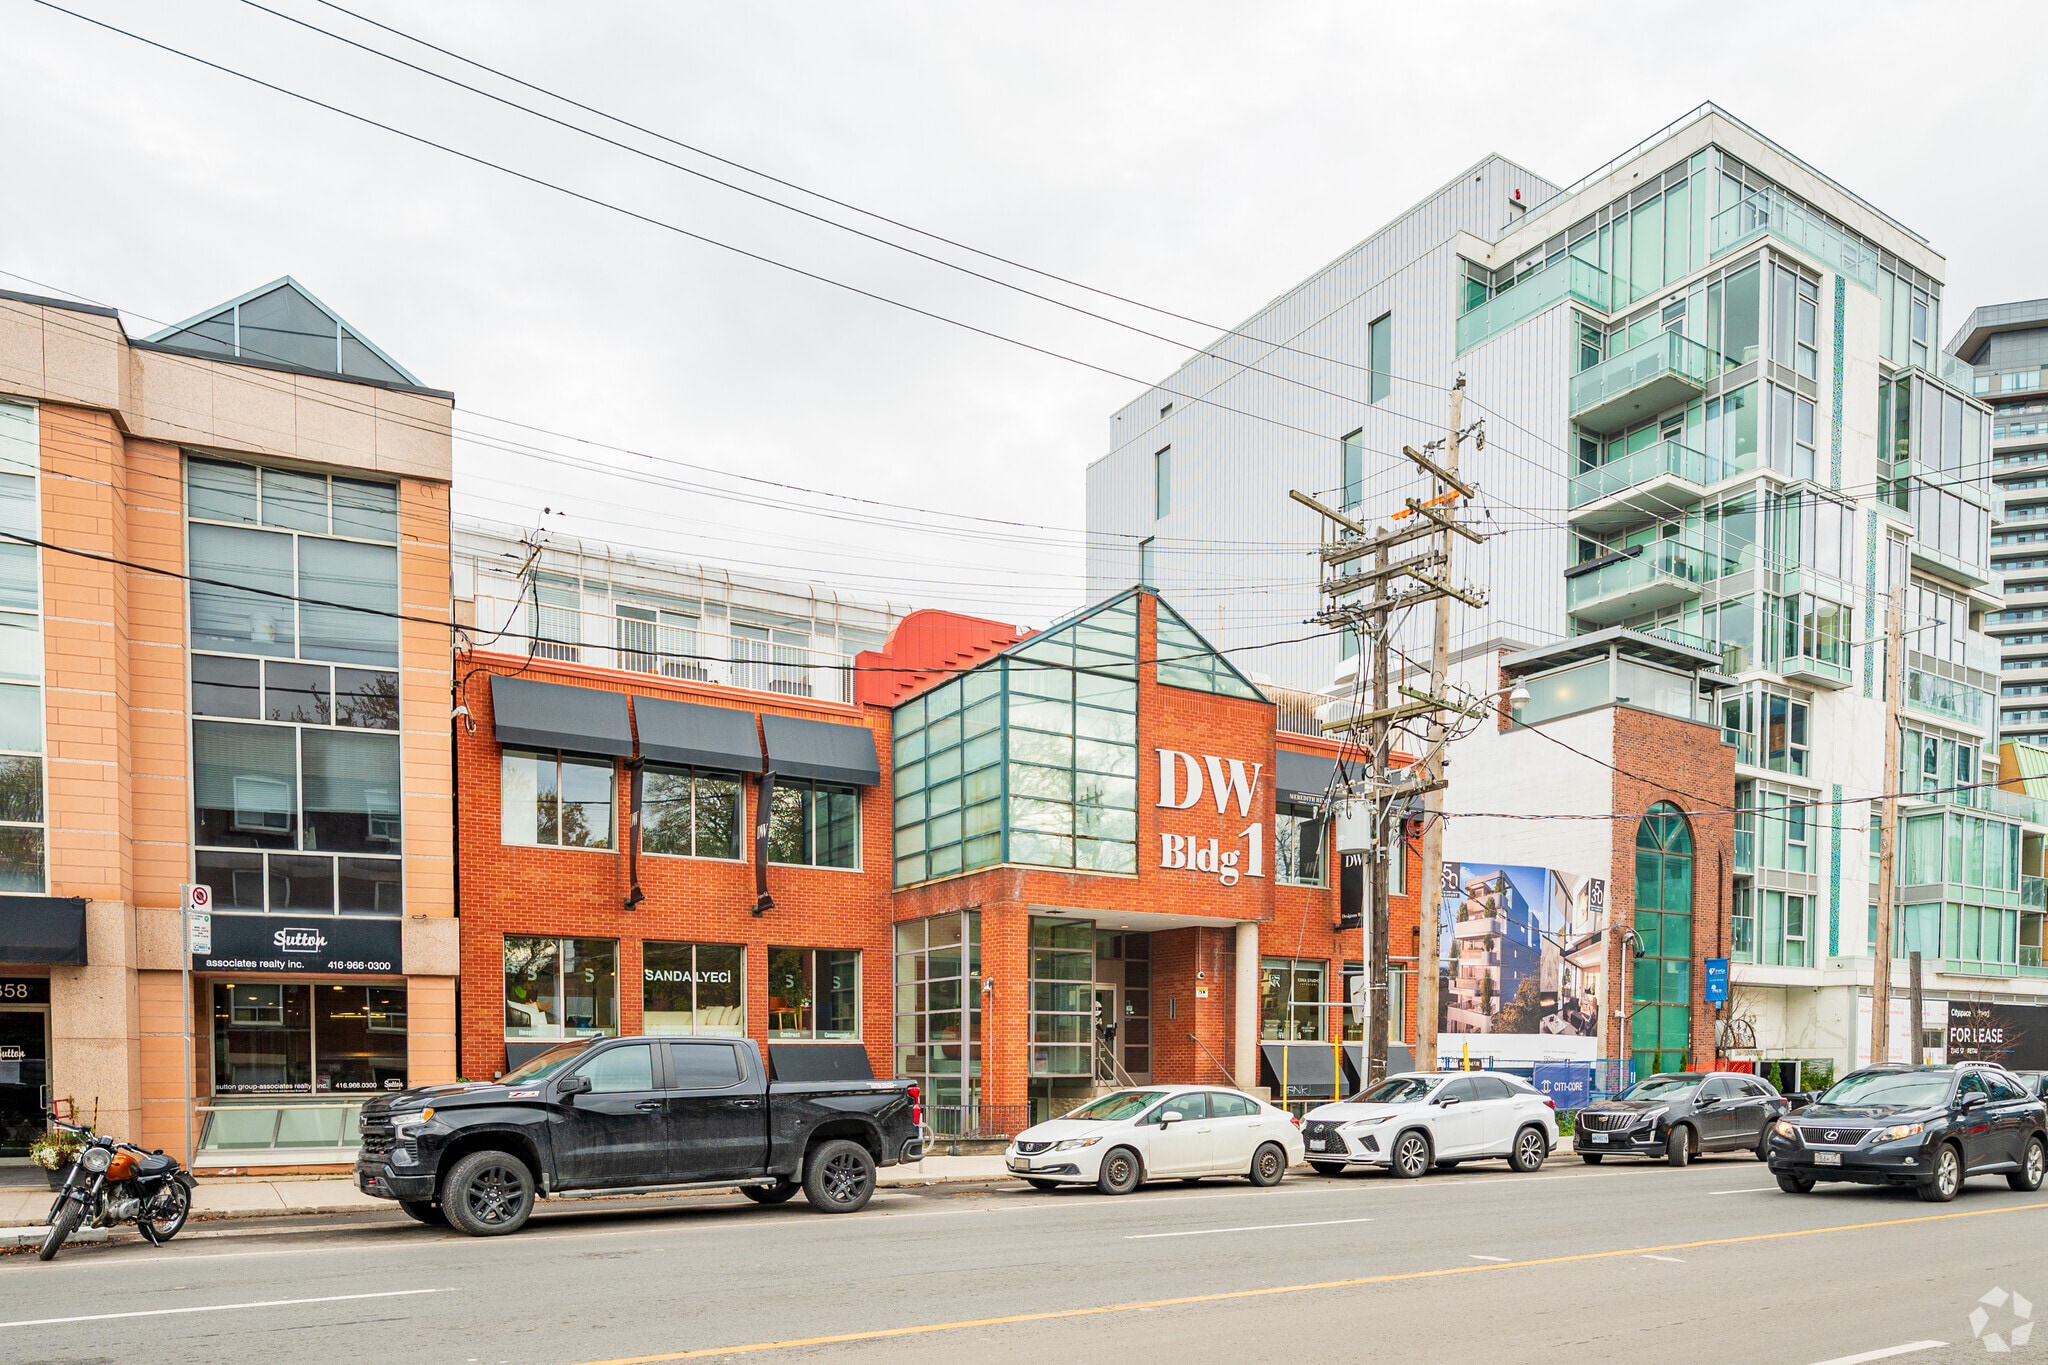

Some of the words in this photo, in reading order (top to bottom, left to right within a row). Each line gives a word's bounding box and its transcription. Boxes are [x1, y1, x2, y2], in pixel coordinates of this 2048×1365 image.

[1154, 748, 1264, 818] DW
[1159, 832, 1240, 887] Bldg
[1238, 822, 1266, 878] 1
[1345, 853, 1363, 868] DW
[273, 927, 328, 952] Sutton
[206, 958, 257, 968] associates
[259, 959, 286, 970] realty
[287, 960, 305, 969] inc.
[585, 967, 595, 983] S
[785, 974, 795, 988] S
[833, 975, 841, 989] S
[1950, 1027, 1971, 1043] FOR
[1972, 1028, 2004, 1044] LEASE
[0, 1048, 26, 1058] utton
[1553, 1081, 1584, 1092] CITI-CORE
